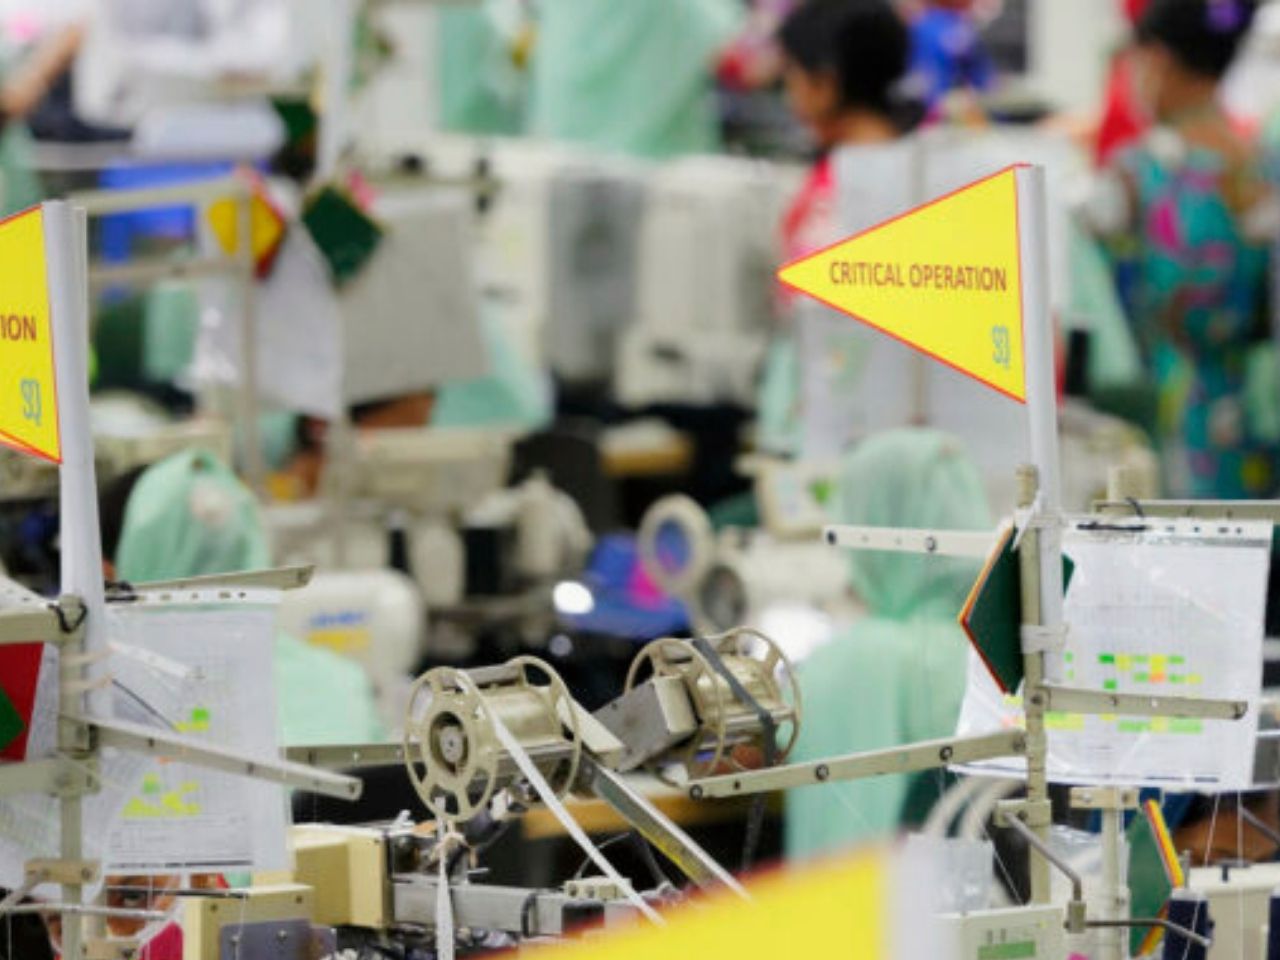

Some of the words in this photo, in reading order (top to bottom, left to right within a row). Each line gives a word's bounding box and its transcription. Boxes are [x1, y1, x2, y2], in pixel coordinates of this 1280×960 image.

[829, 261, 905, 287] CRITICAL
[909, 265, 1008, 291] OPERATION
[0, 314, 36, 342] ION
